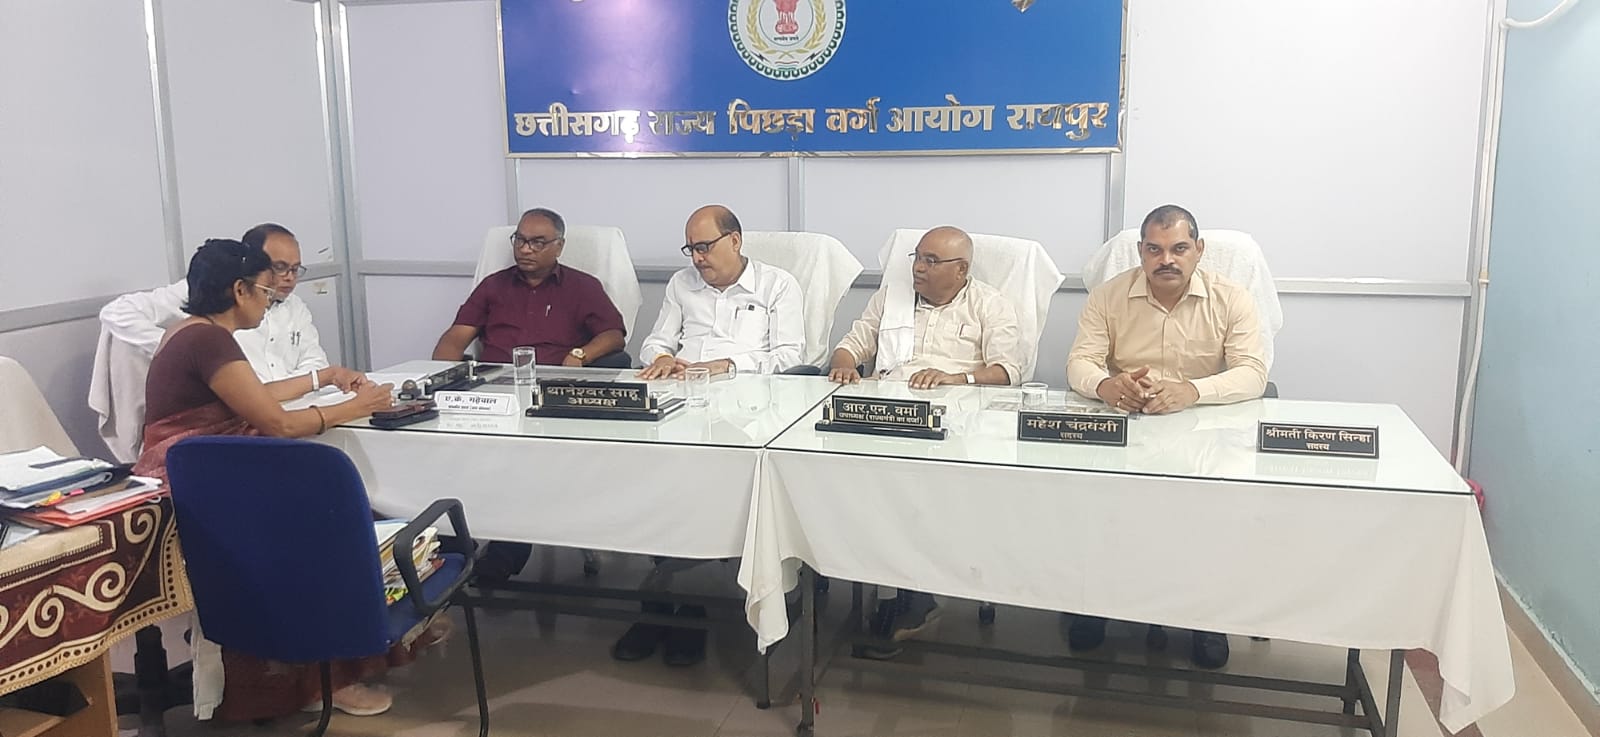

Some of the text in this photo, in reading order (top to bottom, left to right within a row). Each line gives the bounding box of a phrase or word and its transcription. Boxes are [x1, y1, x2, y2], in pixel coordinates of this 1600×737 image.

[514, 94, 1109, 144] छत्तीसगढ़ राज्य पिछड़ा वर्ग आयोग रायपुर
[568, 397, 618, 407] अध्यक्ष
[895, 404, 918, 416] वर्मा
[1027, 416, 1118, 432] महेश चंद्रवंशी
[1266, 428, 1371, 443] श्रीमती किरण सिन्हा
[1306, 442, 1330, 450] सदस्य
